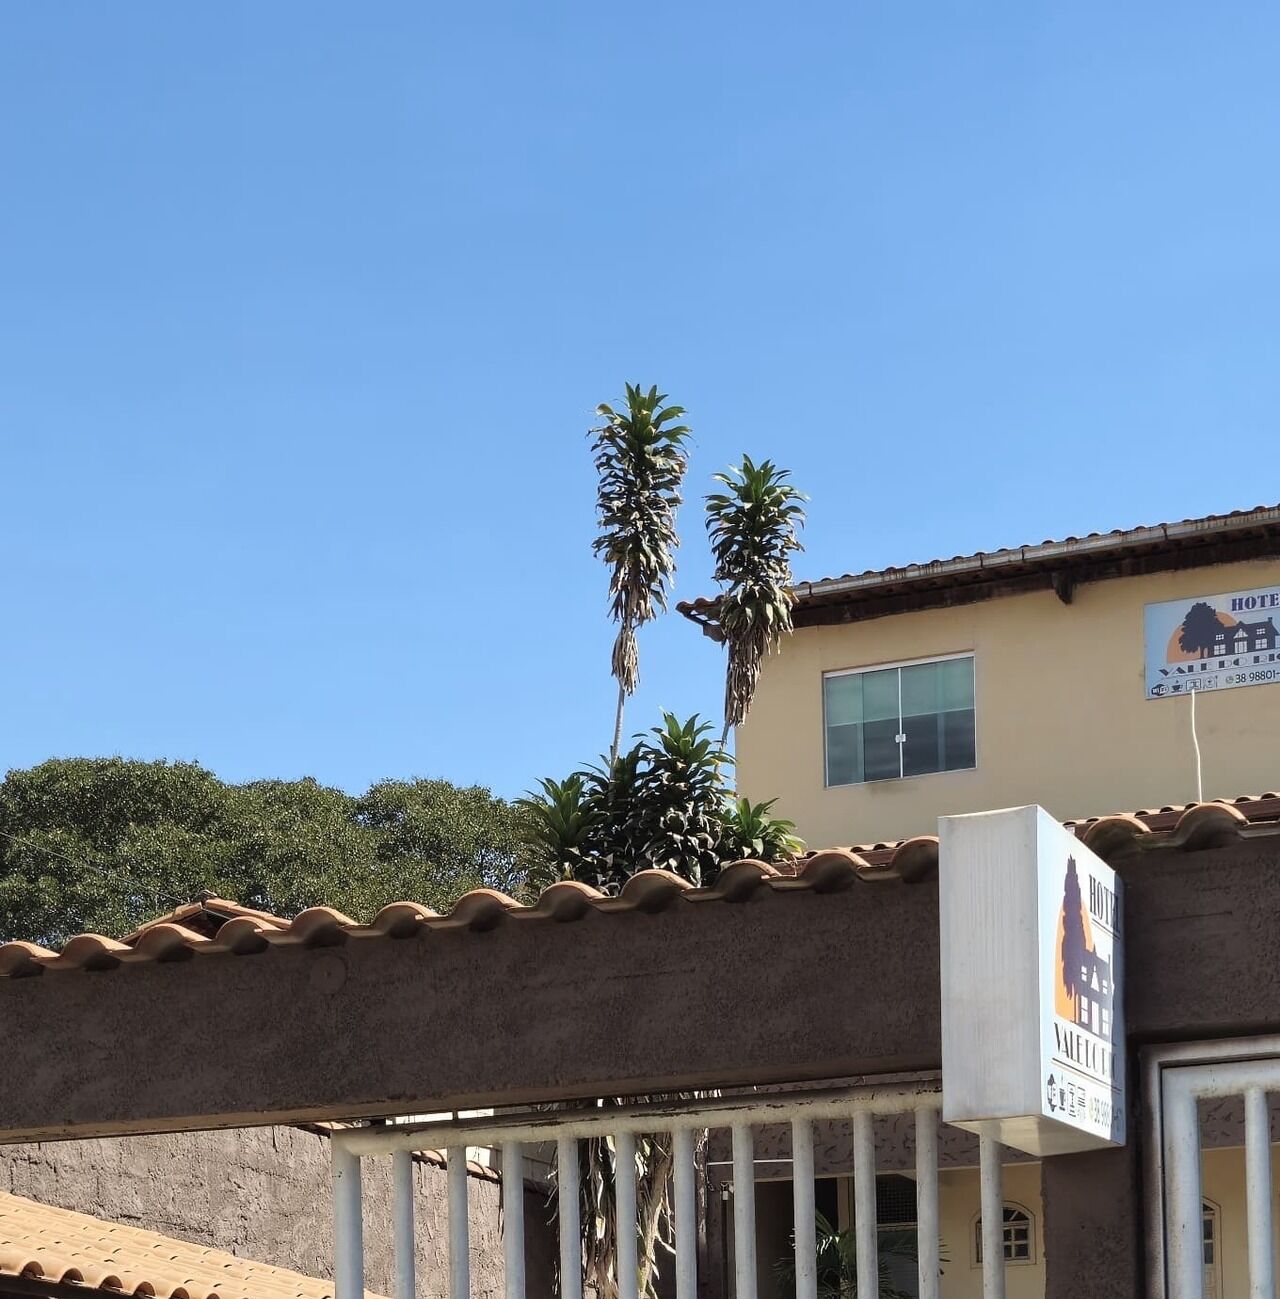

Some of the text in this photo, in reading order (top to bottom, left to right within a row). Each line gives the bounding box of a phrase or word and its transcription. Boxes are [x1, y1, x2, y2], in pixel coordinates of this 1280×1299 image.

[1158, 661, 1214, 677] VALE
[1218, 655, 1249, 669] DO
[1235, 674, 1247, 684] 38
[1088, 873, 1121, 934] HOTEL
[1053, 1022, 1082, 1065] VALE
